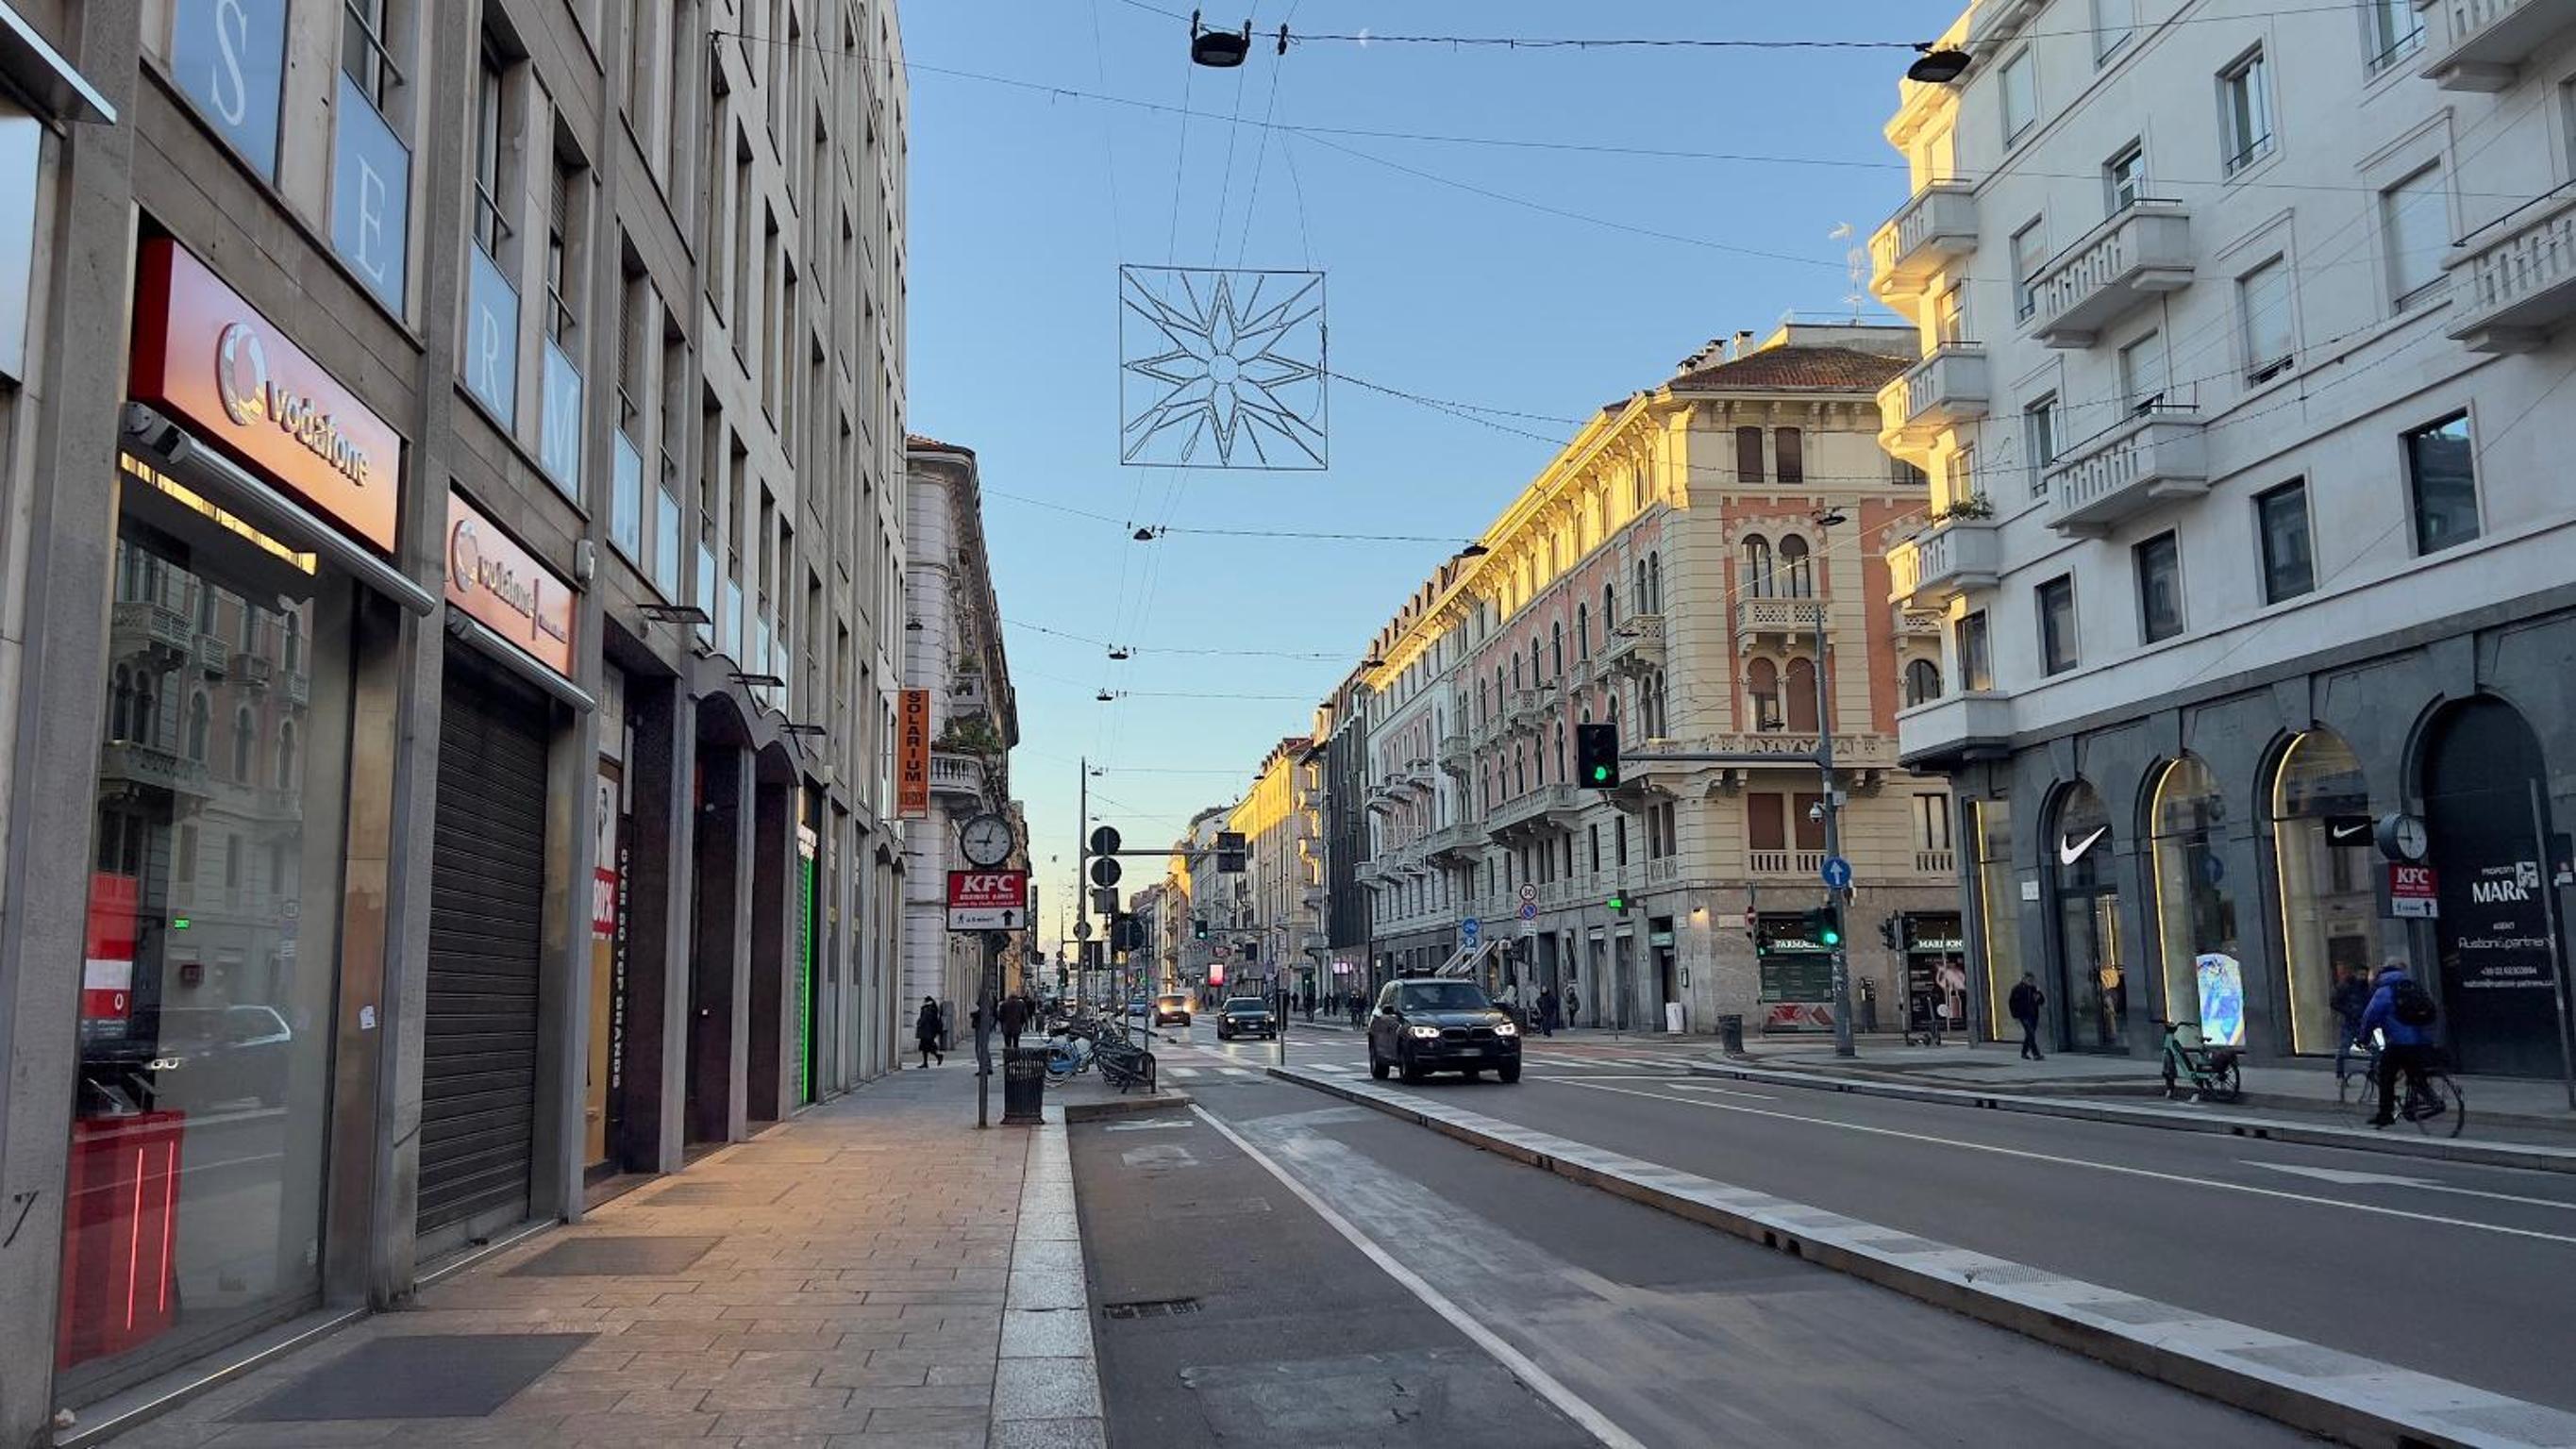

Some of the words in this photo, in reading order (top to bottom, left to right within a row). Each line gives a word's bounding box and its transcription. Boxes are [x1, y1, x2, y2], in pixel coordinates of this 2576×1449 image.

[211, 0, 247, 126] S
[357, 153, 387, 285] E
[479, 302, 503, 415] R
[265, 379, 369, 487] vodafone
[905, 691, 922, 782] SOLARIUM
[961, 874, 1014, 893] KFC
[2397, 866, 2430, 885] KFC
[2472, 879, 2529, 904] MARK
